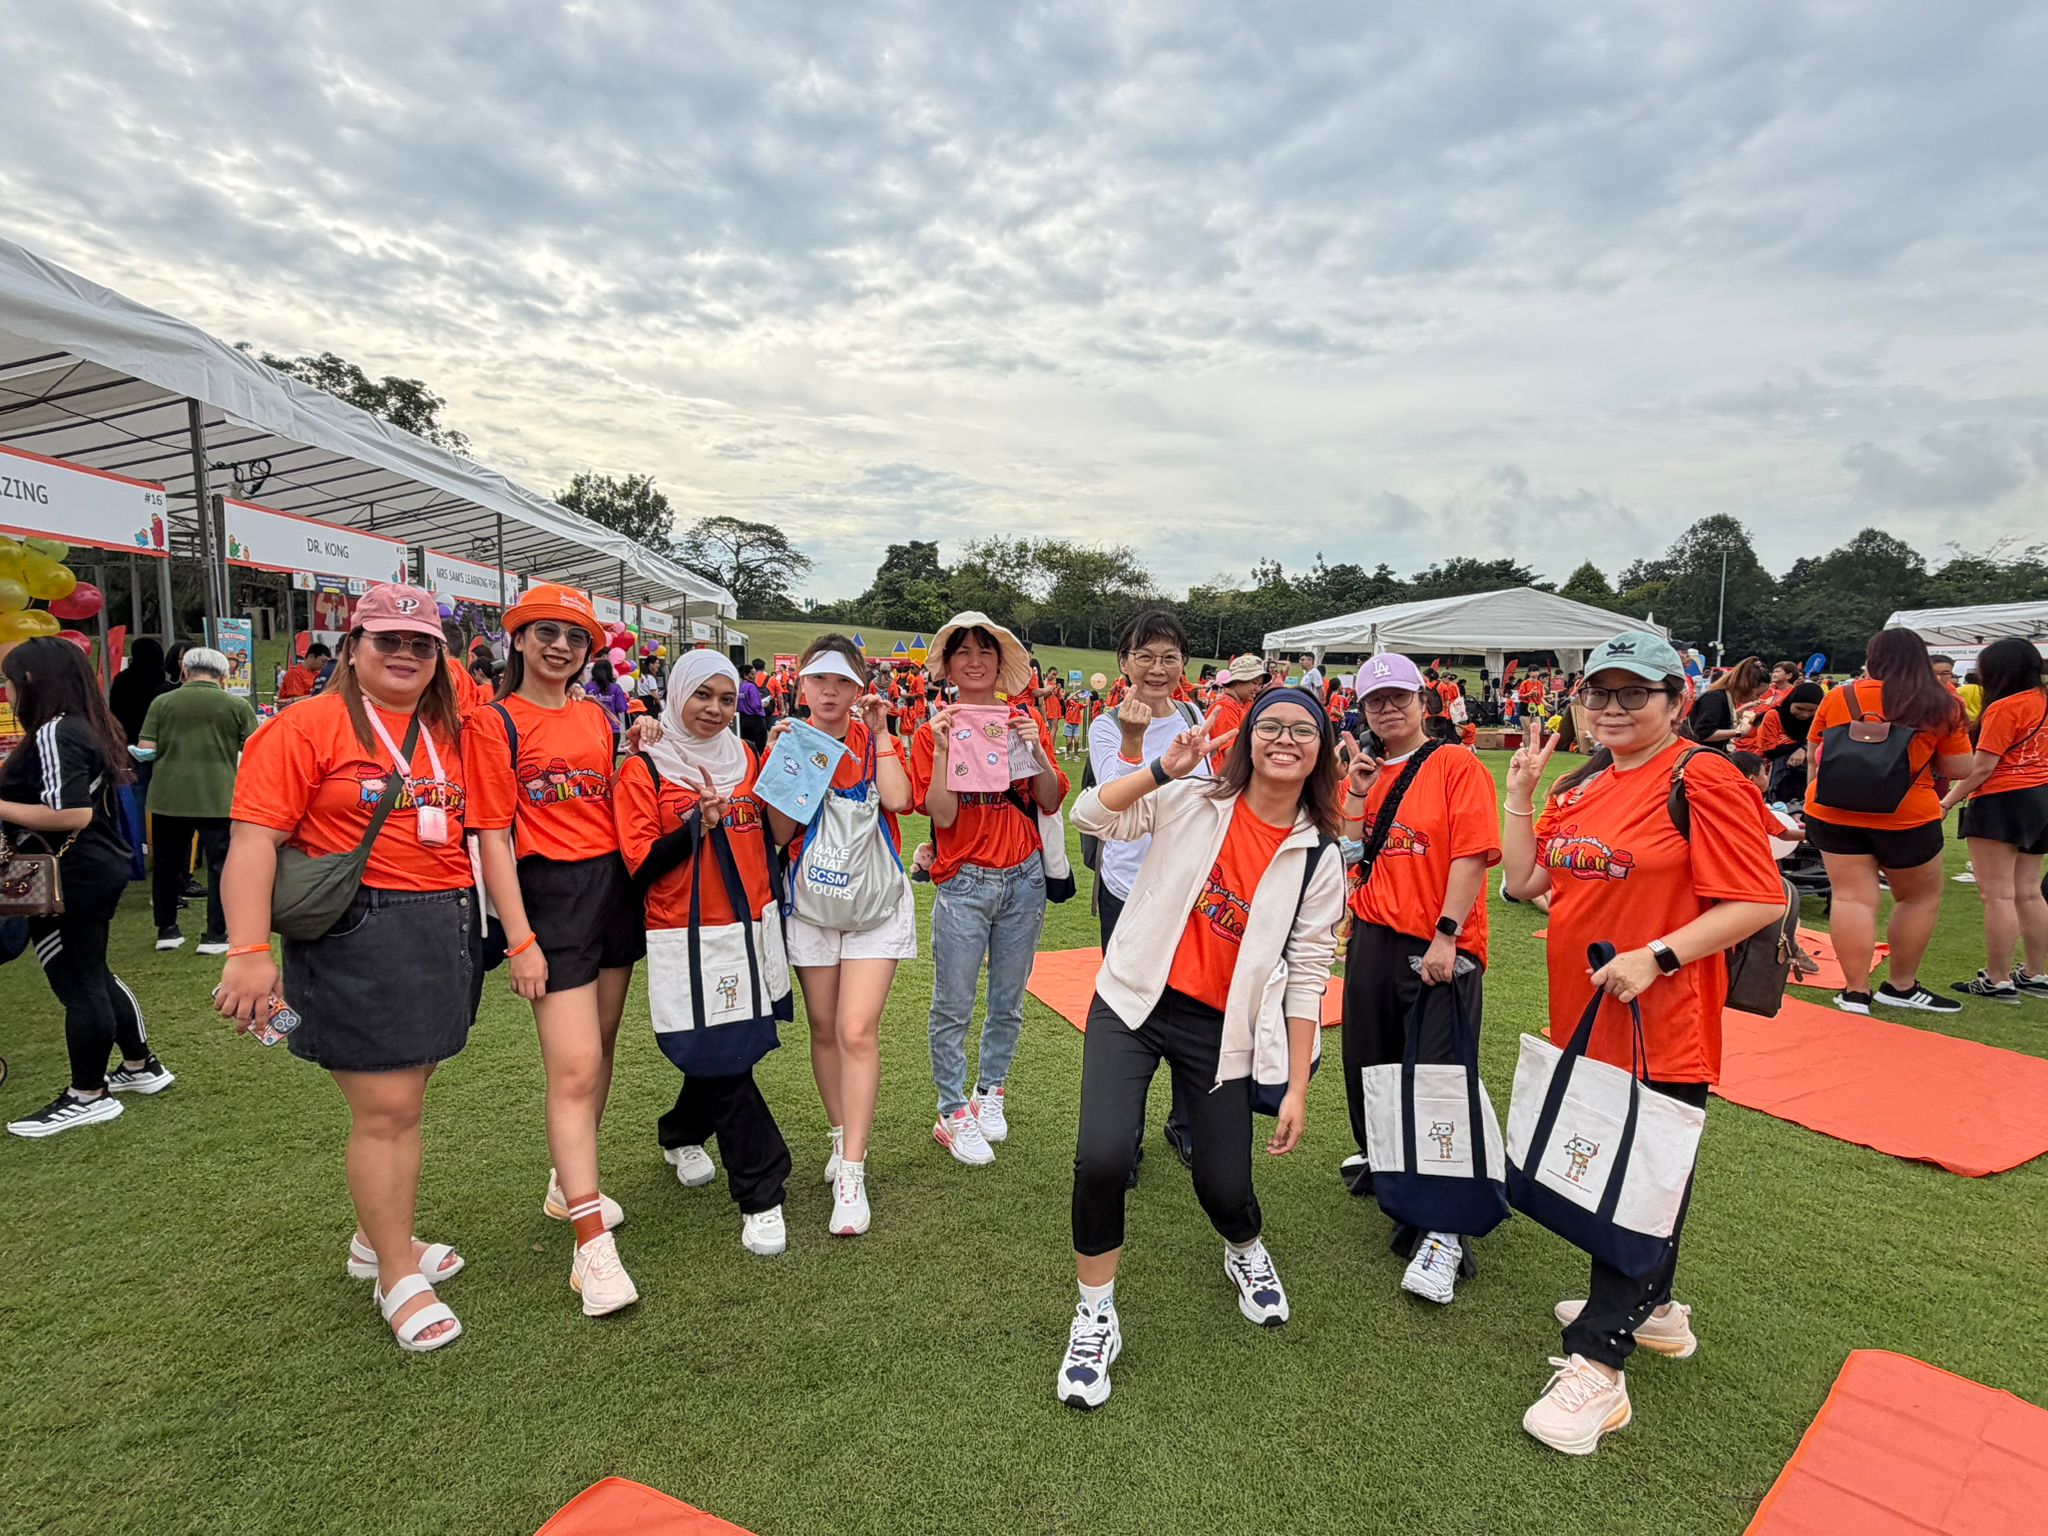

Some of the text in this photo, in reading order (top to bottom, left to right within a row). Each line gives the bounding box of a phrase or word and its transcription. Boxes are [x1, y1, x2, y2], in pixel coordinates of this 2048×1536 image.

[0, 476, 49, 504] ZING
[144, 492, 163, 506] #16
[307, 538, 350, 559] DR. KONG
[396, 598, 418, 613] P
[1372, 659, 1392, 678] LA
[815, 844, 850, 859] MAKE
[813, 853, 844, 870] THAT
[809, 867, 848, 885] SCSM
[807, 881, 854, 900] YOURS.
